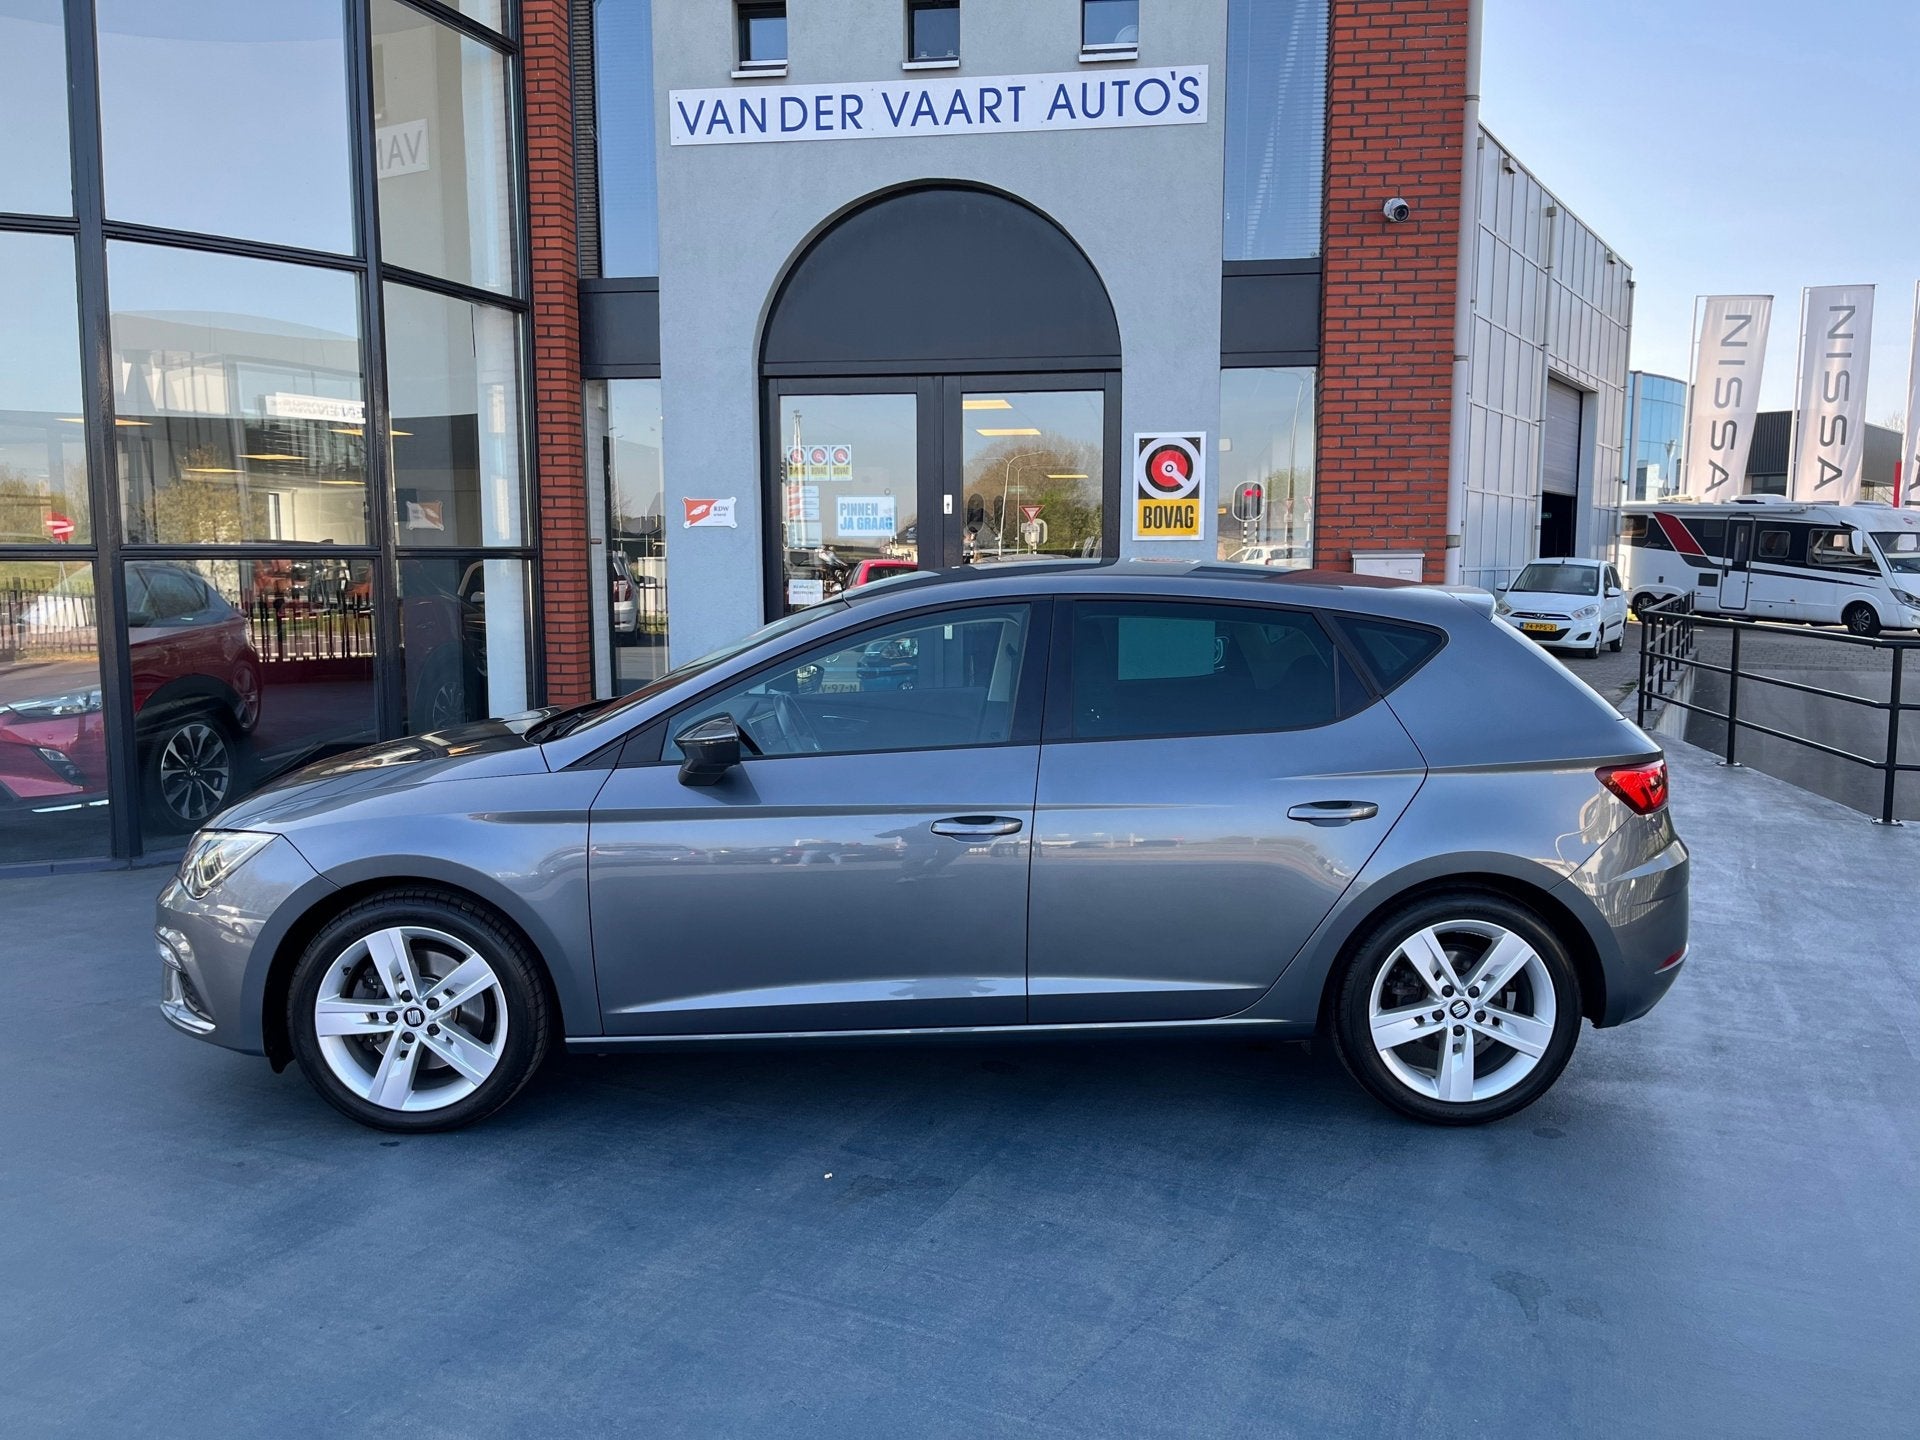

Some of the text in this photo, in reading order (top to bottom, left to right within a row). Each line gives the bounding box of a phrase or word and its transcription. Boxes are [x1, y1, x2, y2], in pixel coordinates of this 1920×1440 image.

[677, 71, 1201, 136] VAN DER VAART AUTO'S
[1813, 305, 1856, 506] NISSA
[840, 502, 878, 516] PINNEN
[1142, 504, 1195, 529] BOVAG
[840, 516, 893, 530] JA GRAAG
